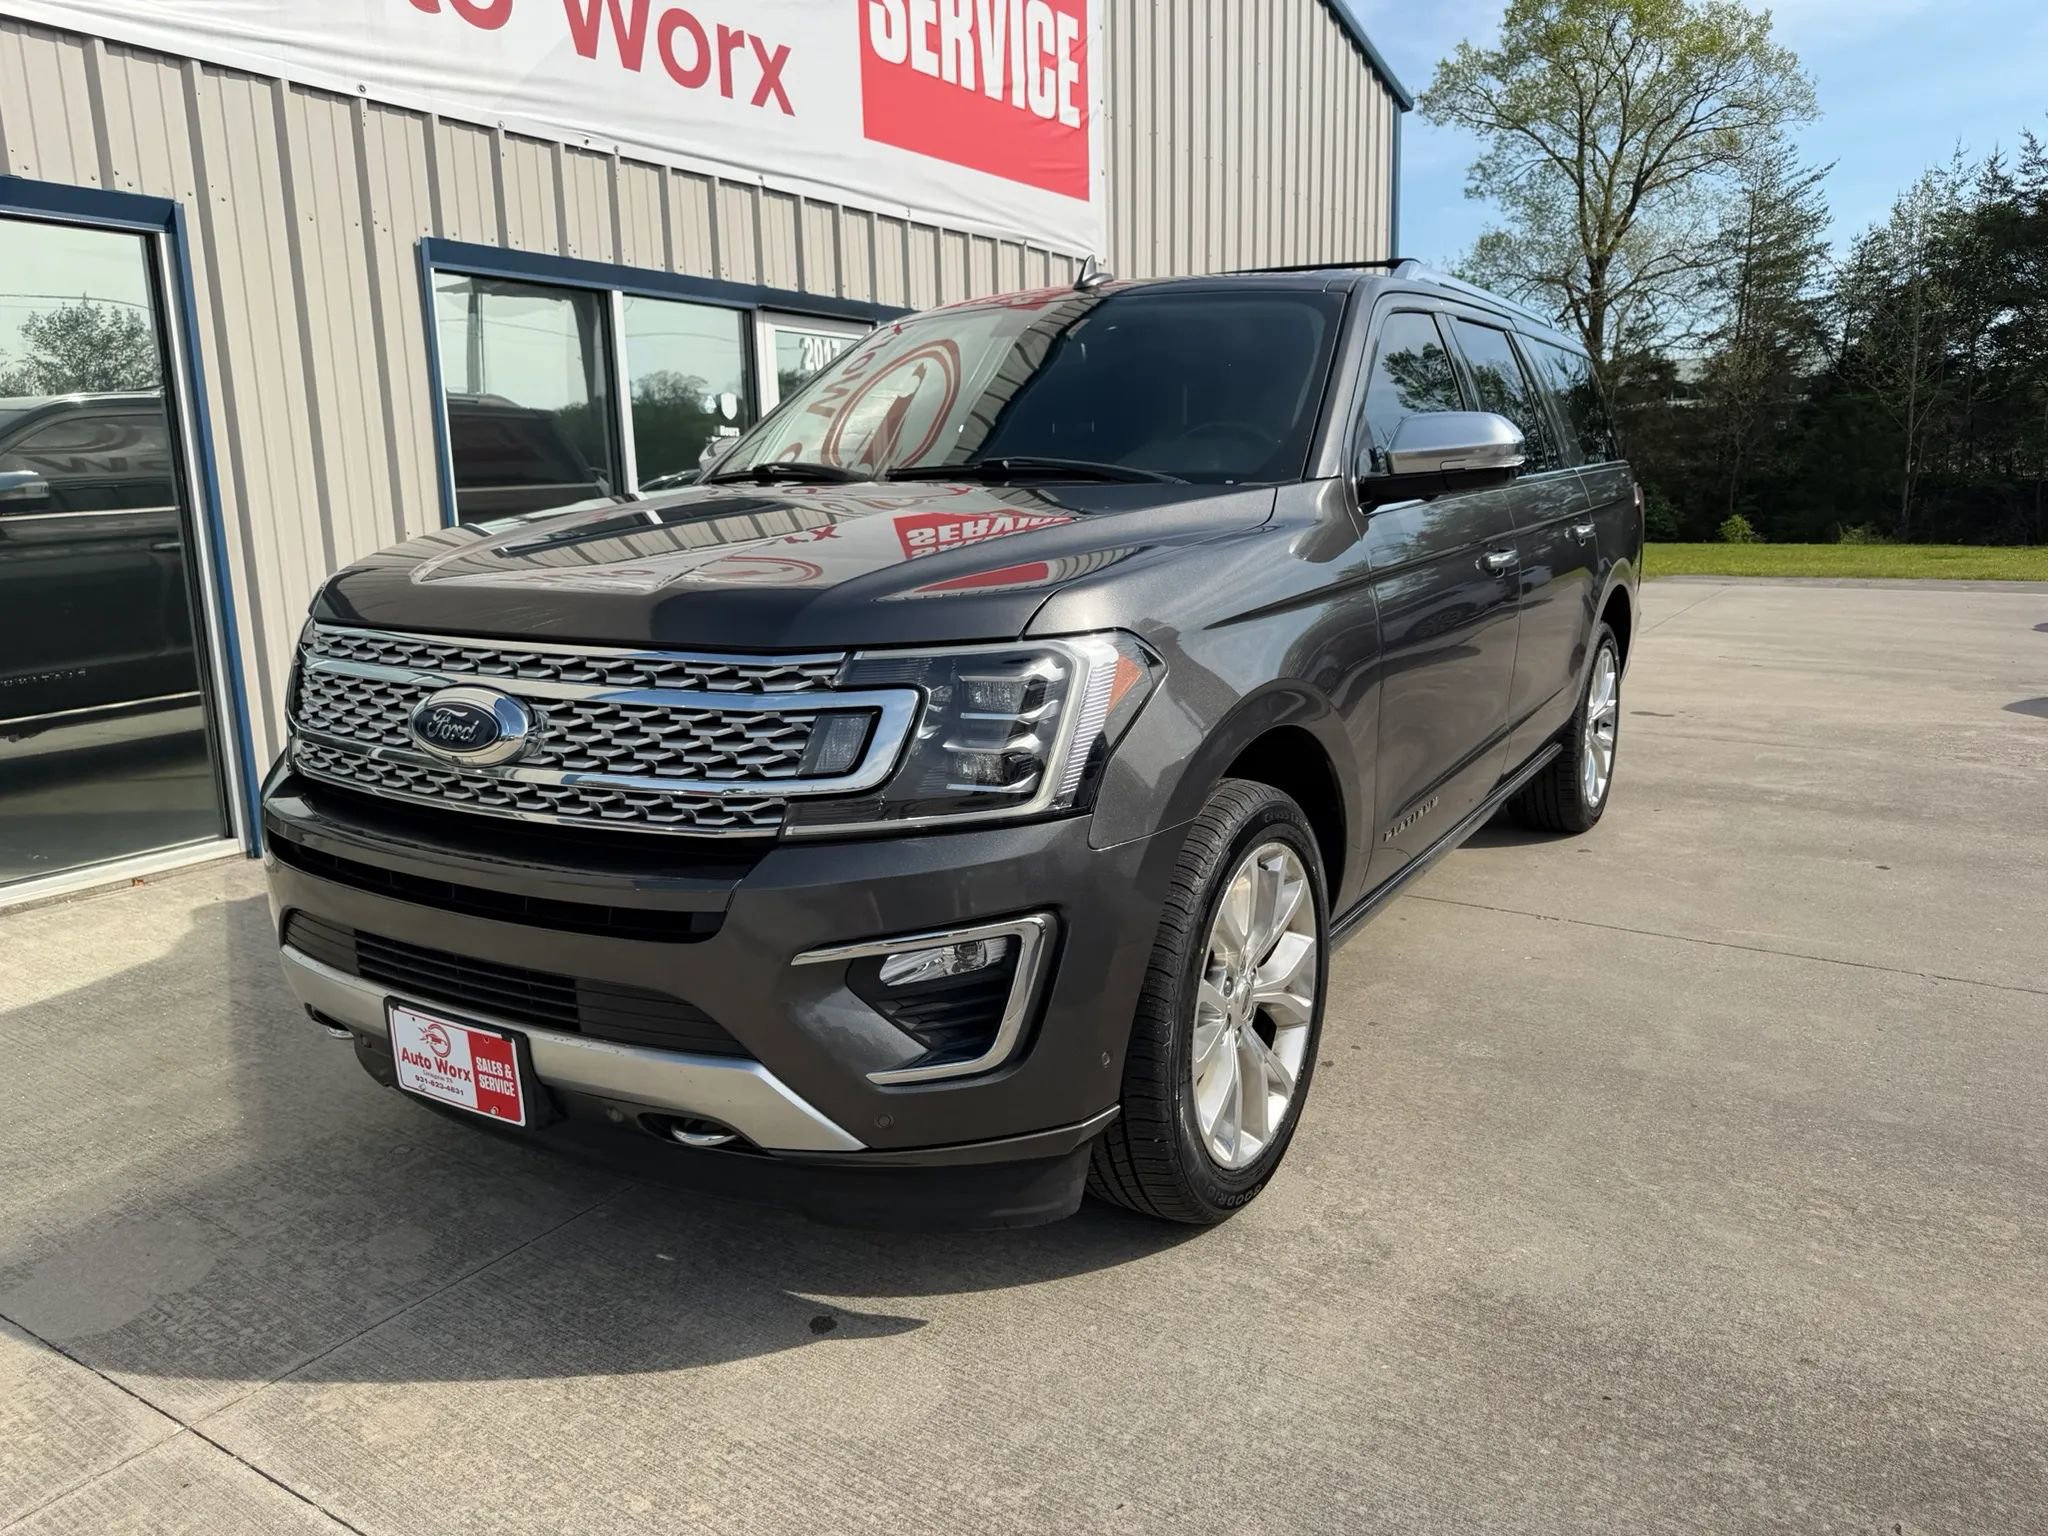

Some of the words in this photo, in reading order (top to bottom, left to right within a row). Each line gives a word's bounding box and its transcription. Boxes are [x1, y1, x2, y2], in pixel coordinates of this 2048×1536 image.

[563, 0, 795, 117] Worx
[427, 707, 480, 743] Ford
[1383, 796, 1438, 842] PLATINUM
[401, 1047, 432, 1070] Auto
[434, 1056, 472, 1082] Worx
[476, 1056, 503, 1076] SALES
[503, 1064, 513, 1079] &
[478, 1074, 516, 1097] SERVICE
